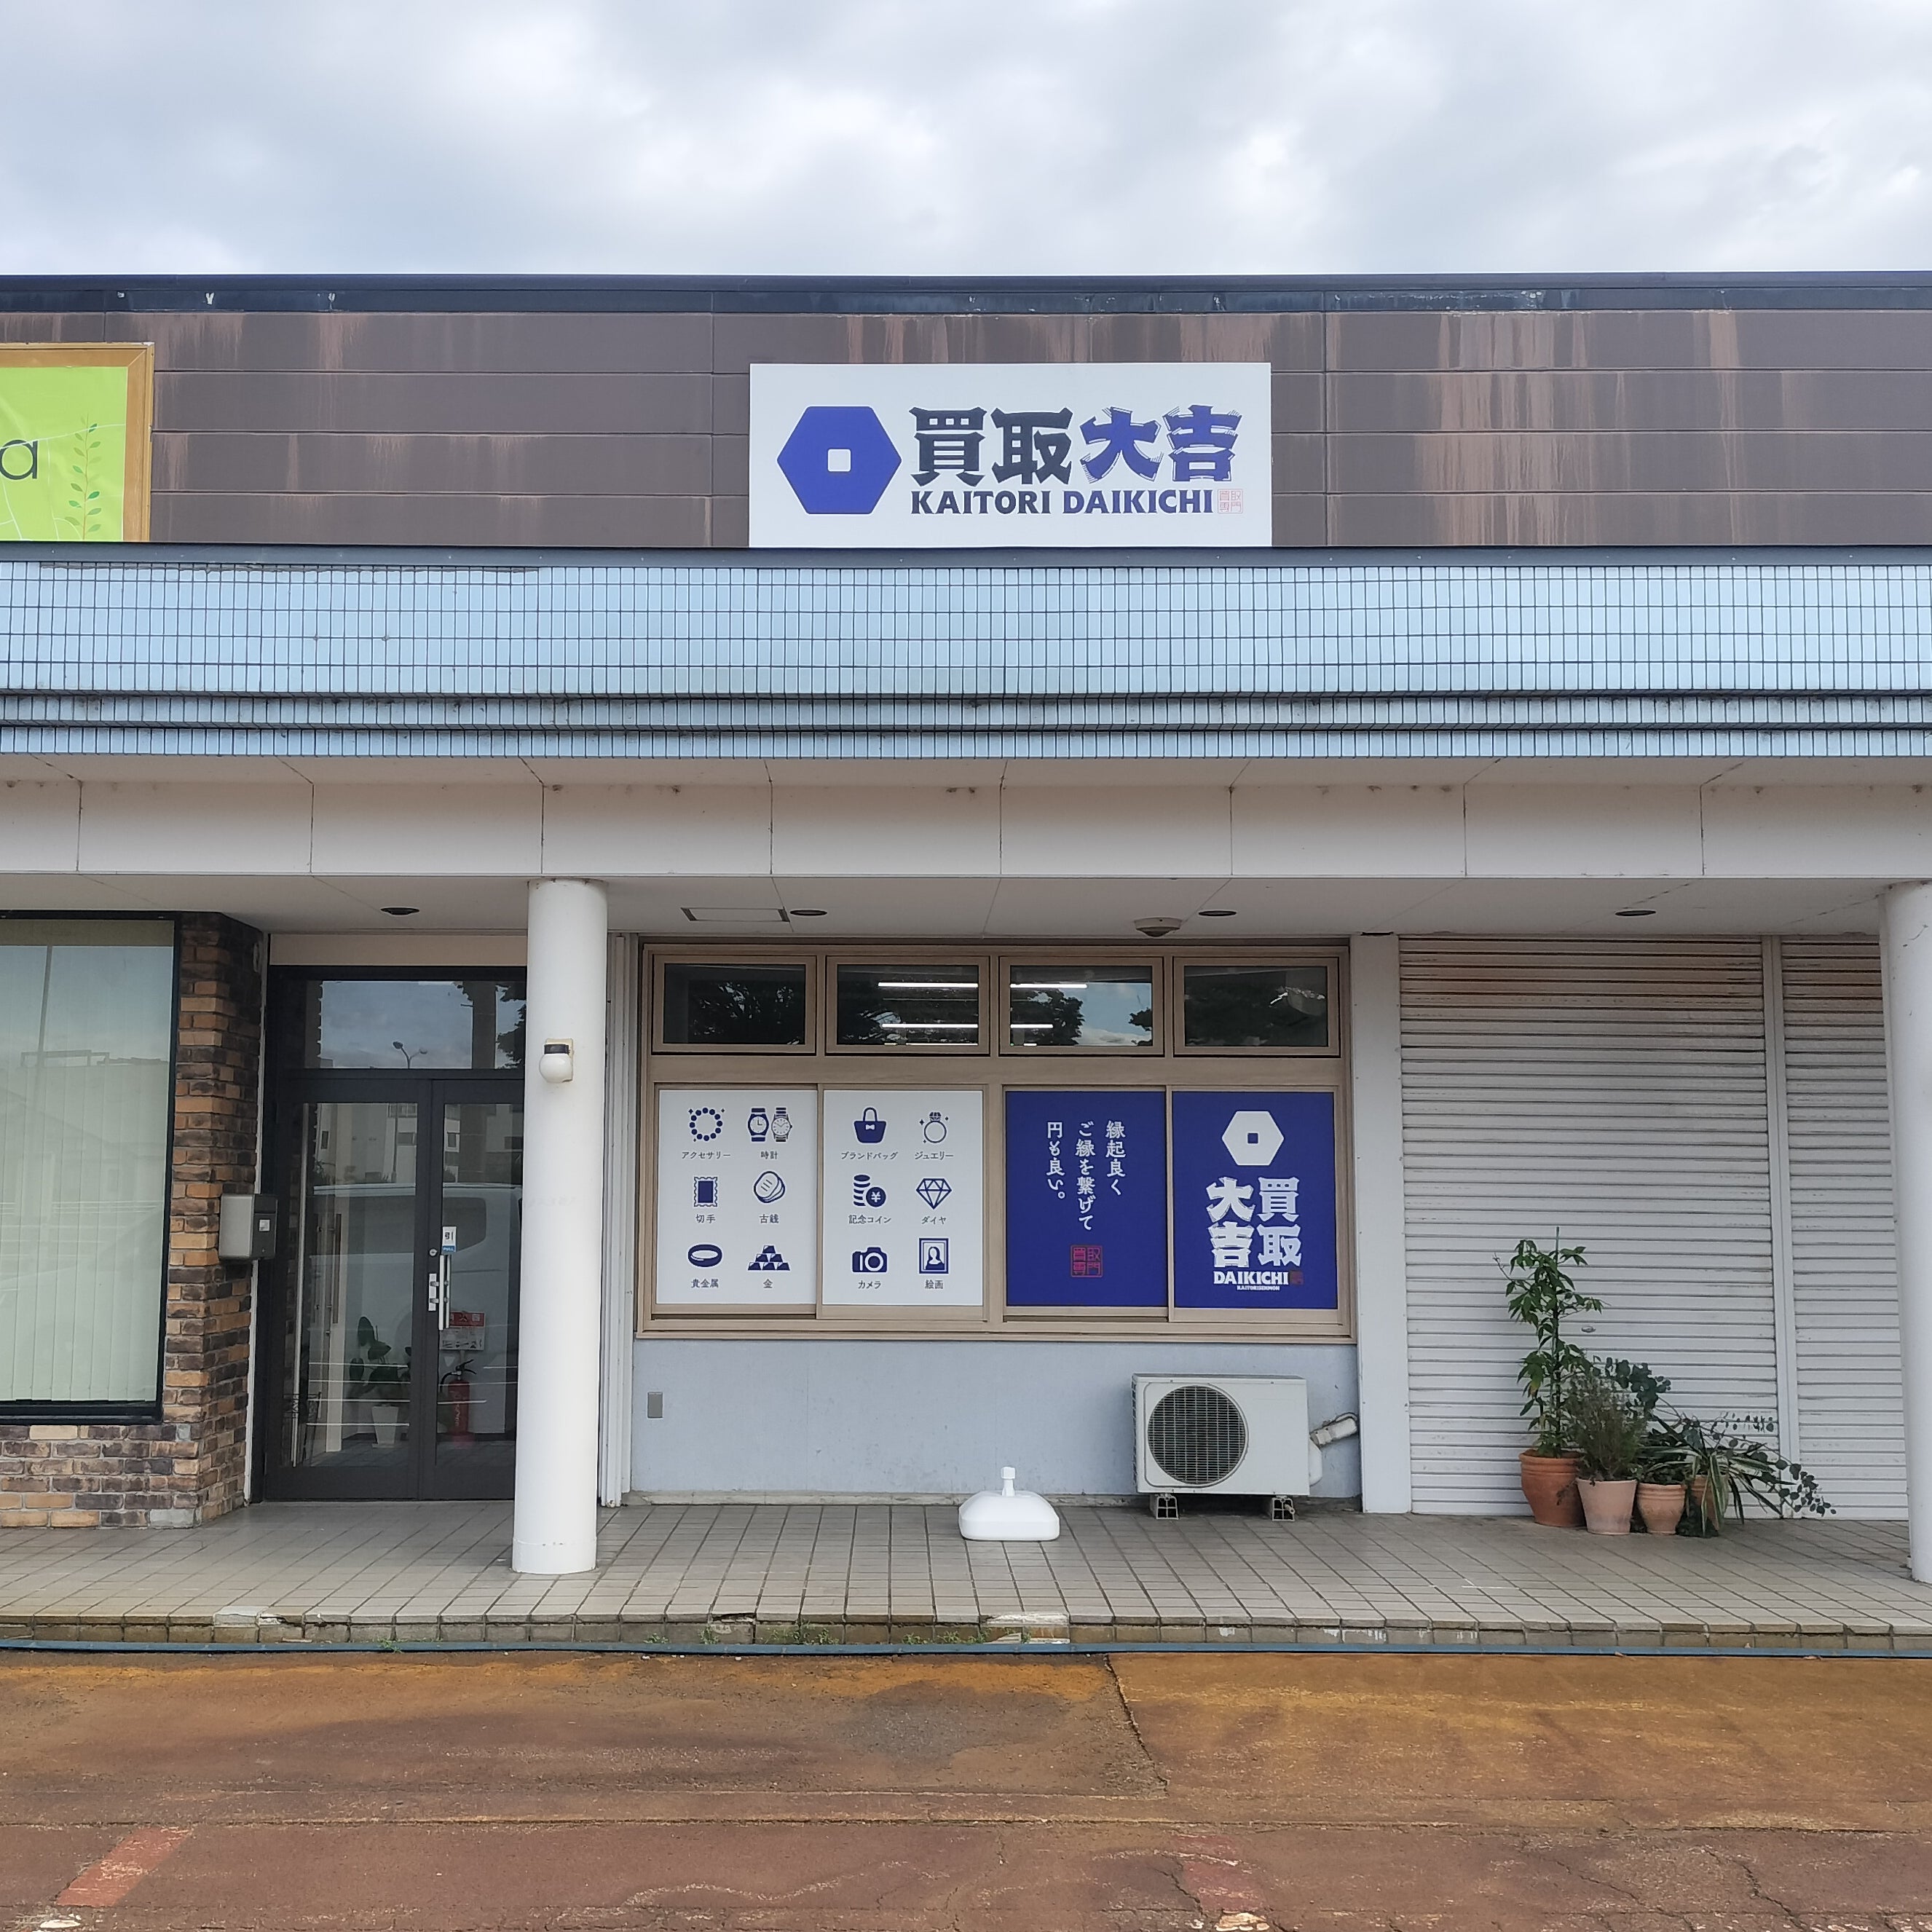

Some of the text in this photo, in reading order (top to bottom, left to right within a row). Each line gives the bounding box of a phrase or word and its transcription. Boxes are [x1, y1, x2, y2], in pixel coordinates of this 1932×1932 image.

[909, 405, 1242, 486] 買取大吉
[911, 489, 1213, 514] KAITORI DAIKICHI
[682, 1151, 731, 1160] アクセサリー
[760, 1150, 778, 1160] 時計
[841, 1151, 899, 1161] ブランドバッグ
[914, 1151, 954, 1161] ジュエリー
[1105, 1120, 1127, 1196] 縁起良く
[1075, 1121, 1097, 1231] ご縁を繋げて
[695, 1213, 716, 1224] 切手
[759, 1213, 779, 1224] 古銭
[848, 1214, 892, 1225] 記念コイン
[921, 1215, 947, 1225] ダイヤ
[1206, 1176, 1256, 1268] 大吉
[1257, 1176, 1302, 1266] 買取
[690, 1278, 719, 1289] 貴金属
[762, 1278, 773, 1289] 金
[1213, 1271, 1289, 1285] DAIKICHI
[857, 1280, 881, 1290] カメラ
[924, 1279, 944, 1290] 絵画
